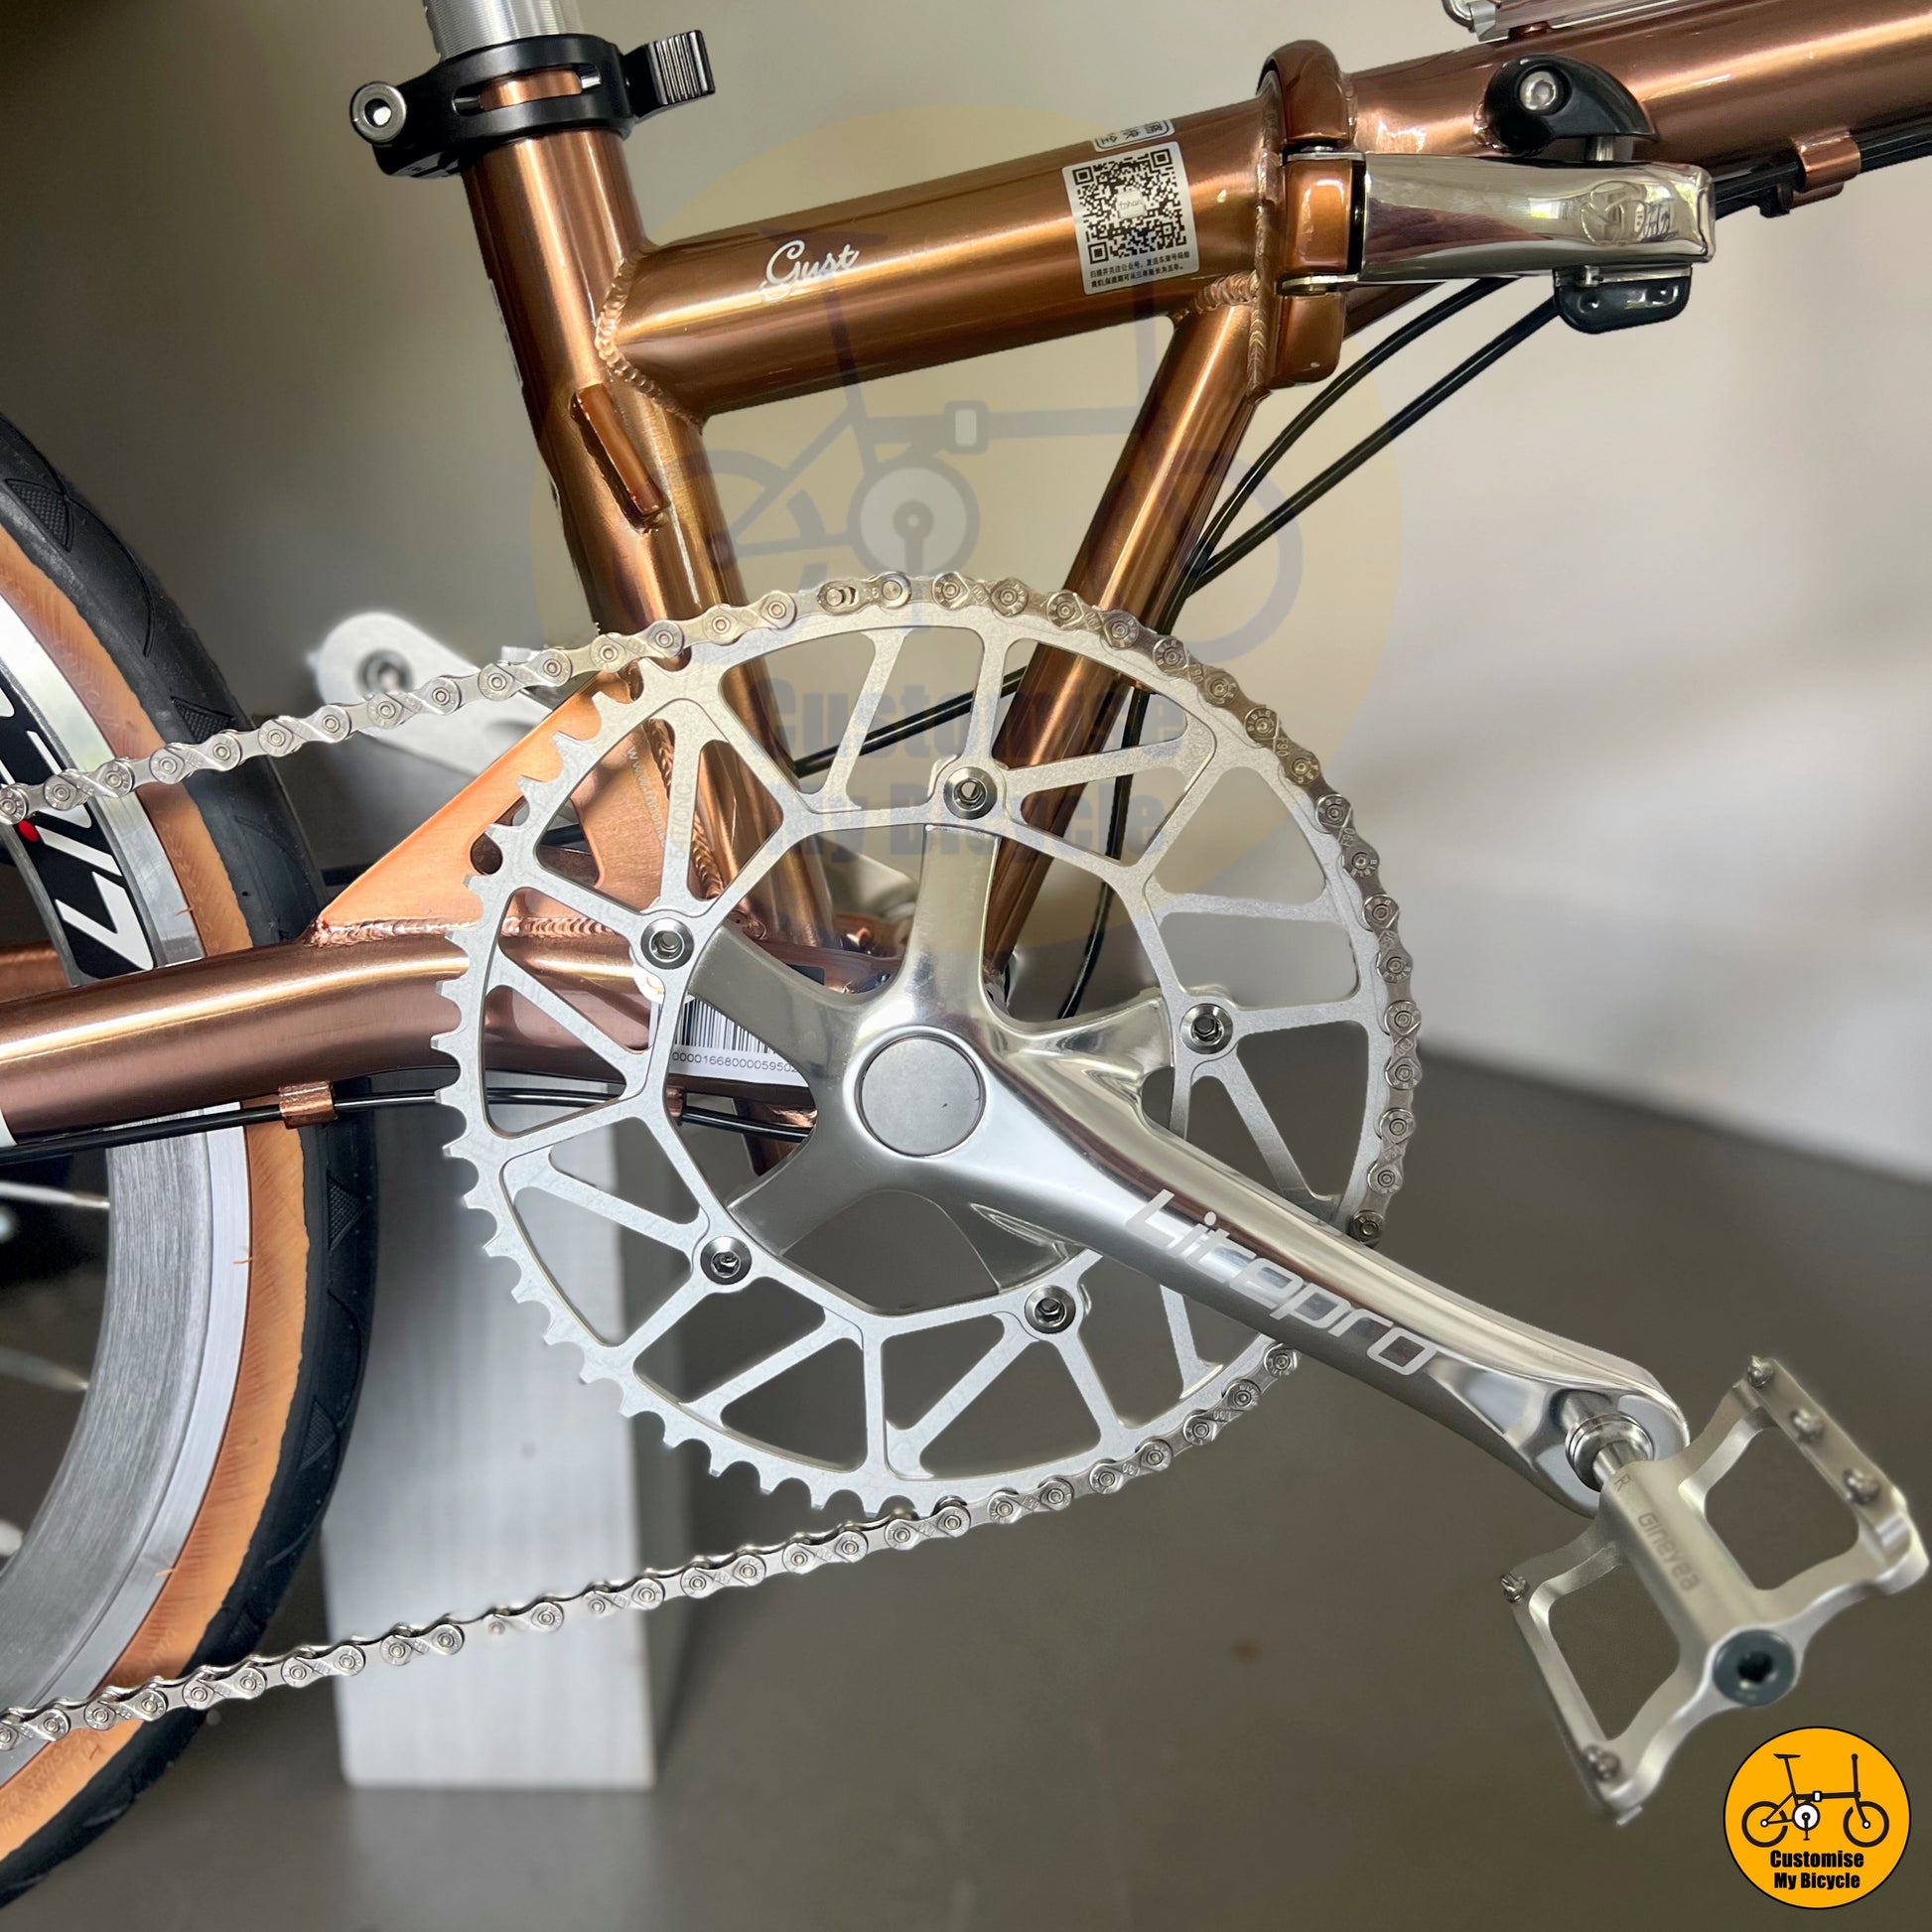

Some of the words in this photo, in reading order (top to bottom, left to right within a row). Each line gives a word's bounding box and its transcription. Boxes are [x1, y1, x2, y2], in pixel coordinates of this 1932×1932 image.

[758, 239, 860, 304] Gust
[1125, 1188, 1438, 1376] Litepro
[1614, 1473, 1631, 1492] R
